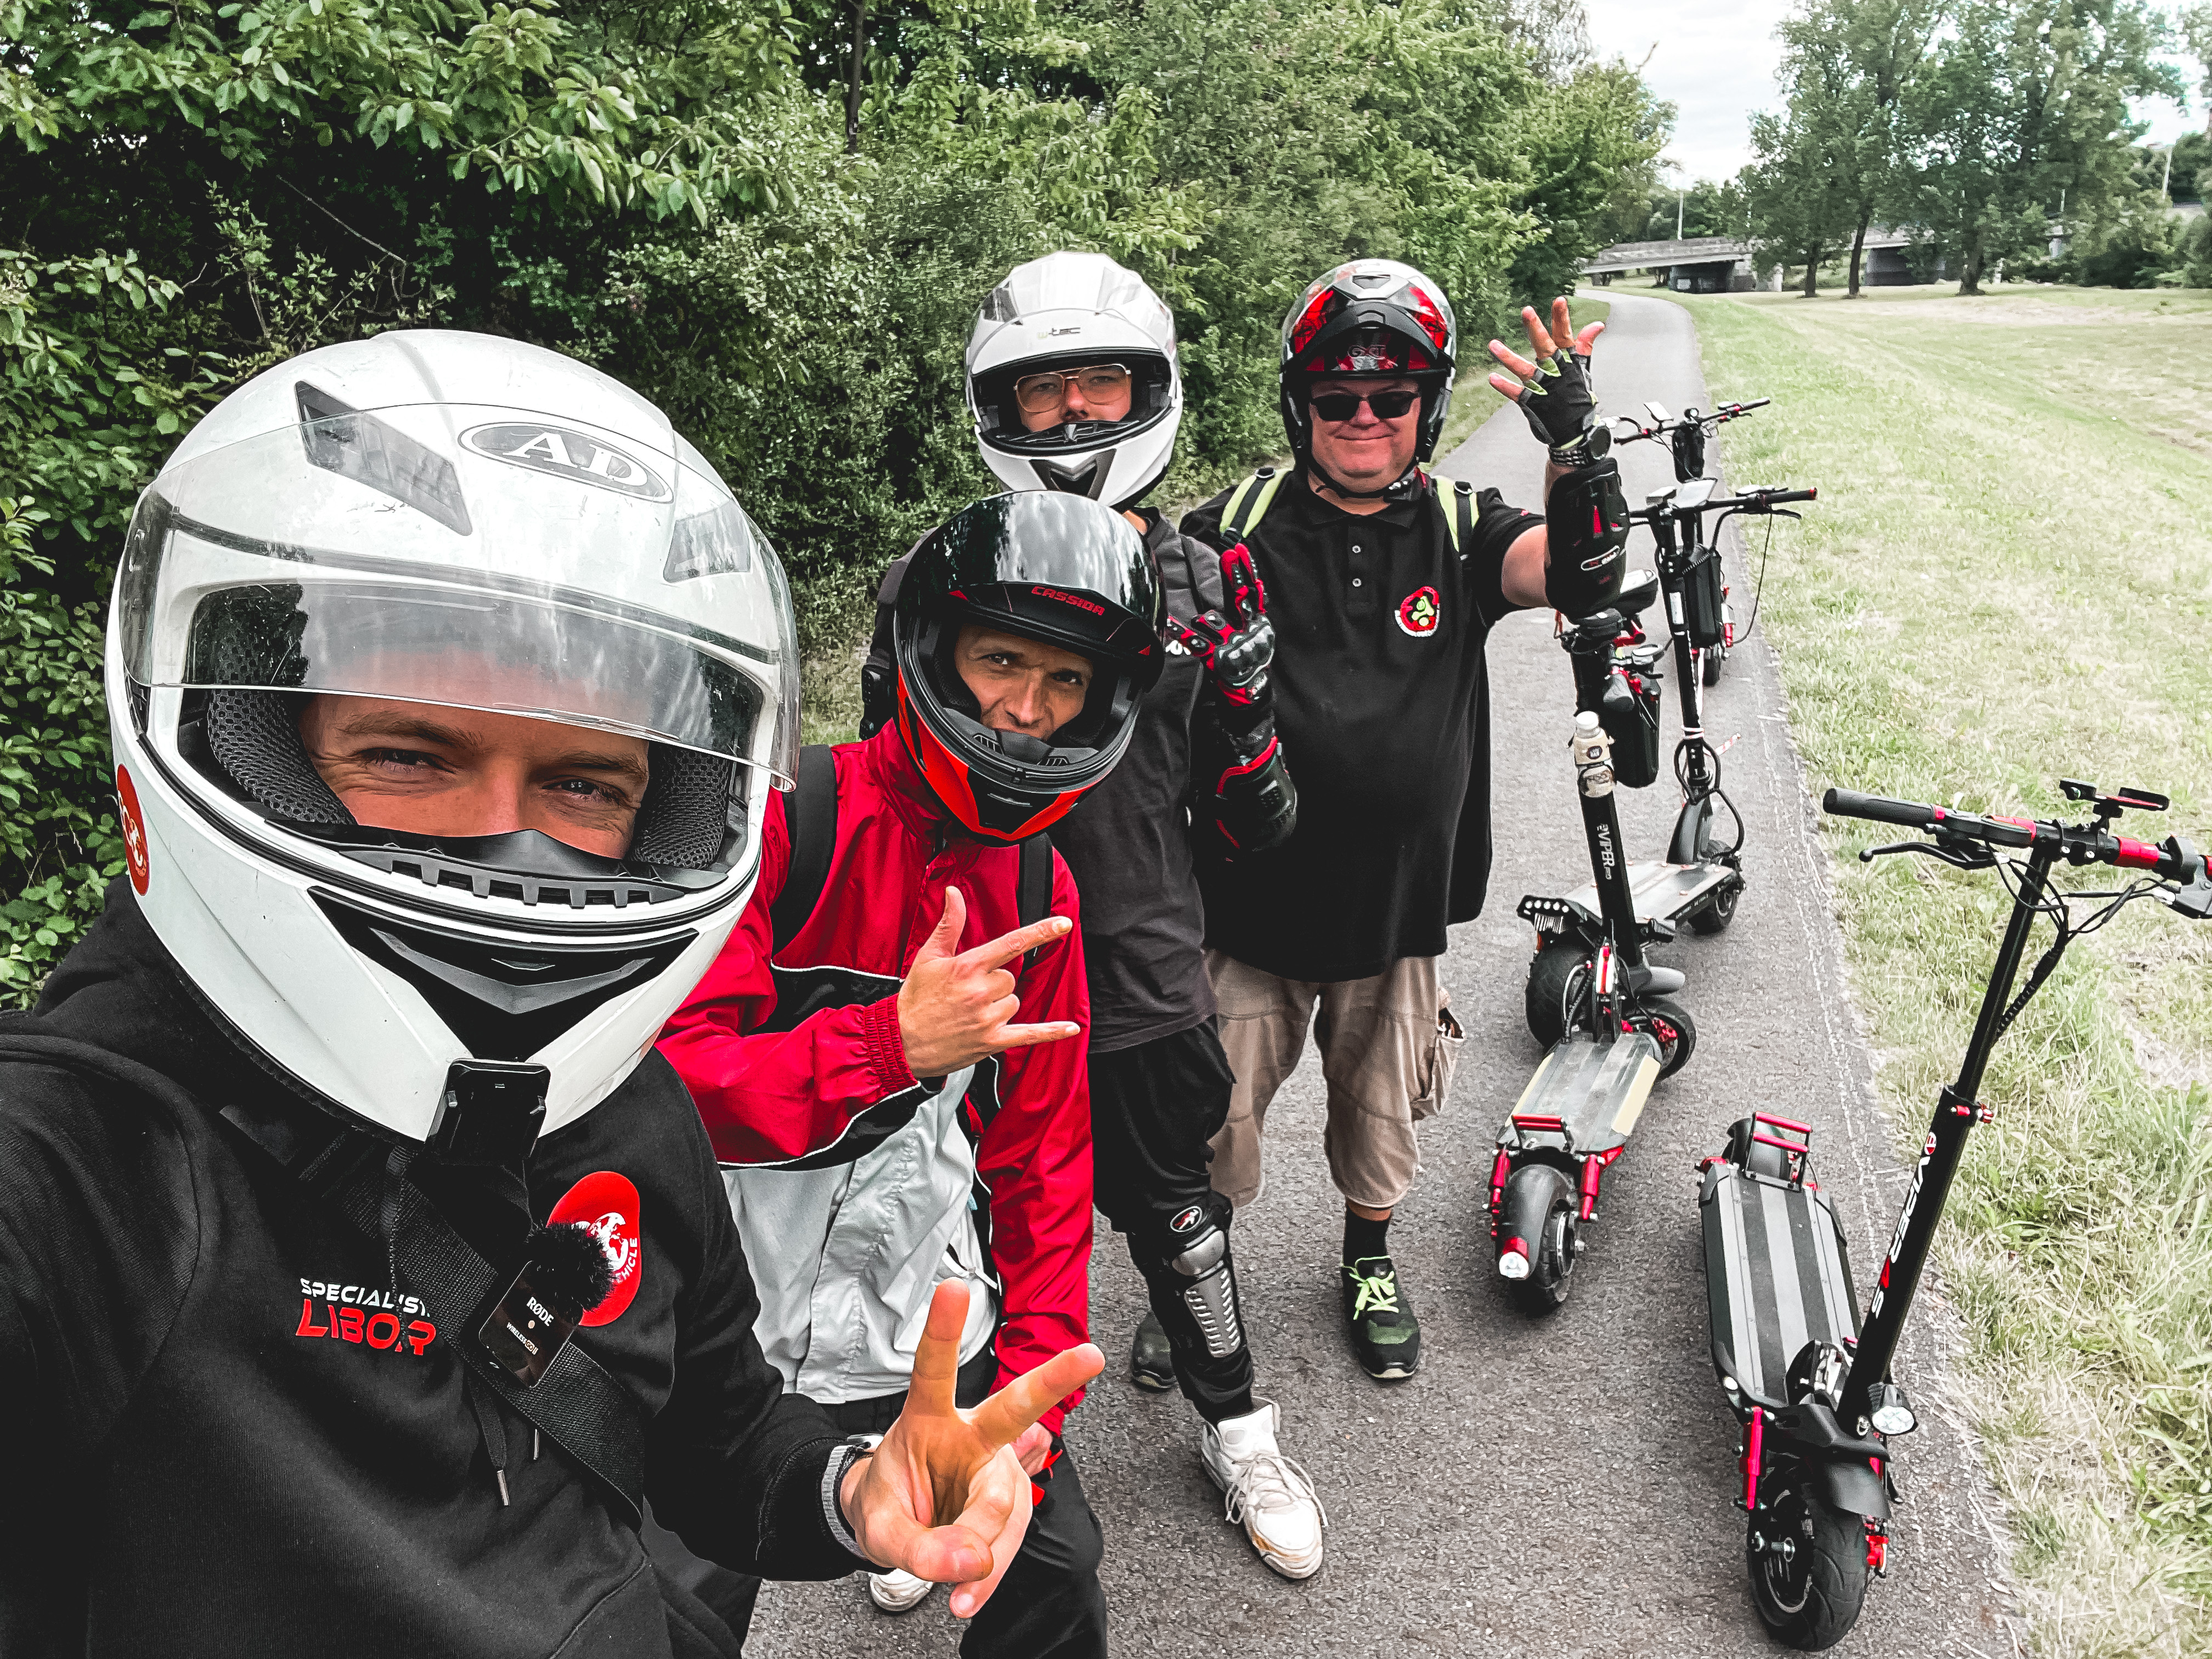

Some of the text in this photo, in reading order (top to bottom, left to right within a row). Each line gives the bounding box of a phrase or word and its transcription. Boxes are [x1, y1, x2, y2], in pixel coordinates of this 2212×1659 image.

[502, 431, 648, 487] AD
[1031, 585, 1105, 616] CASSIDA
[1598, 831, 1615, 867] VIPER
[295, 1298, 436, 1356] LIBOR
[527, 1296, 554, 1327] RØDE
[506, 1322, 527, 1344] WIRELESS
